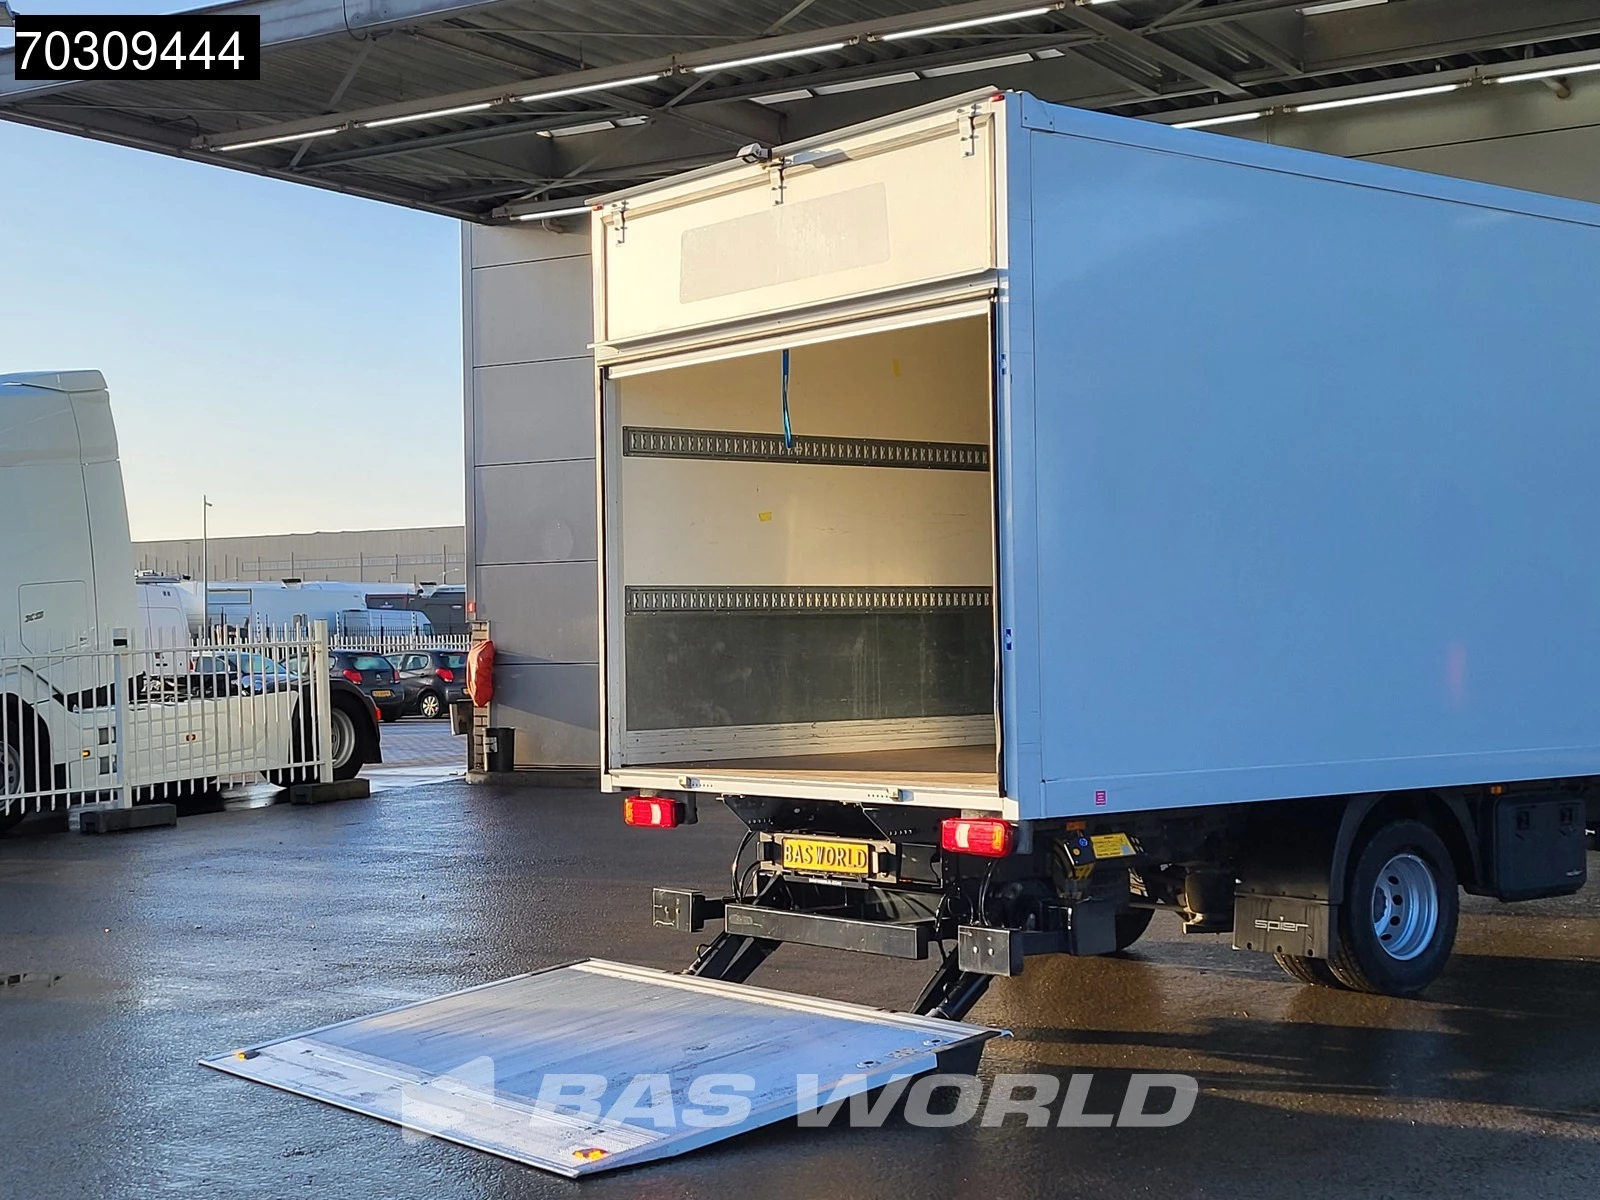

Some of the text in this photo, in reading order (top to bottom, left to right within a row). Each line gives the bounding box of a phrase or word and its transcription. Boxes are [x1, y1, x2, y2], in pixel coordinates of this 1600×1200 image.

[784, 844, 867, 868] BAS WORLD
[1254, 916, 1309, 932] spier
